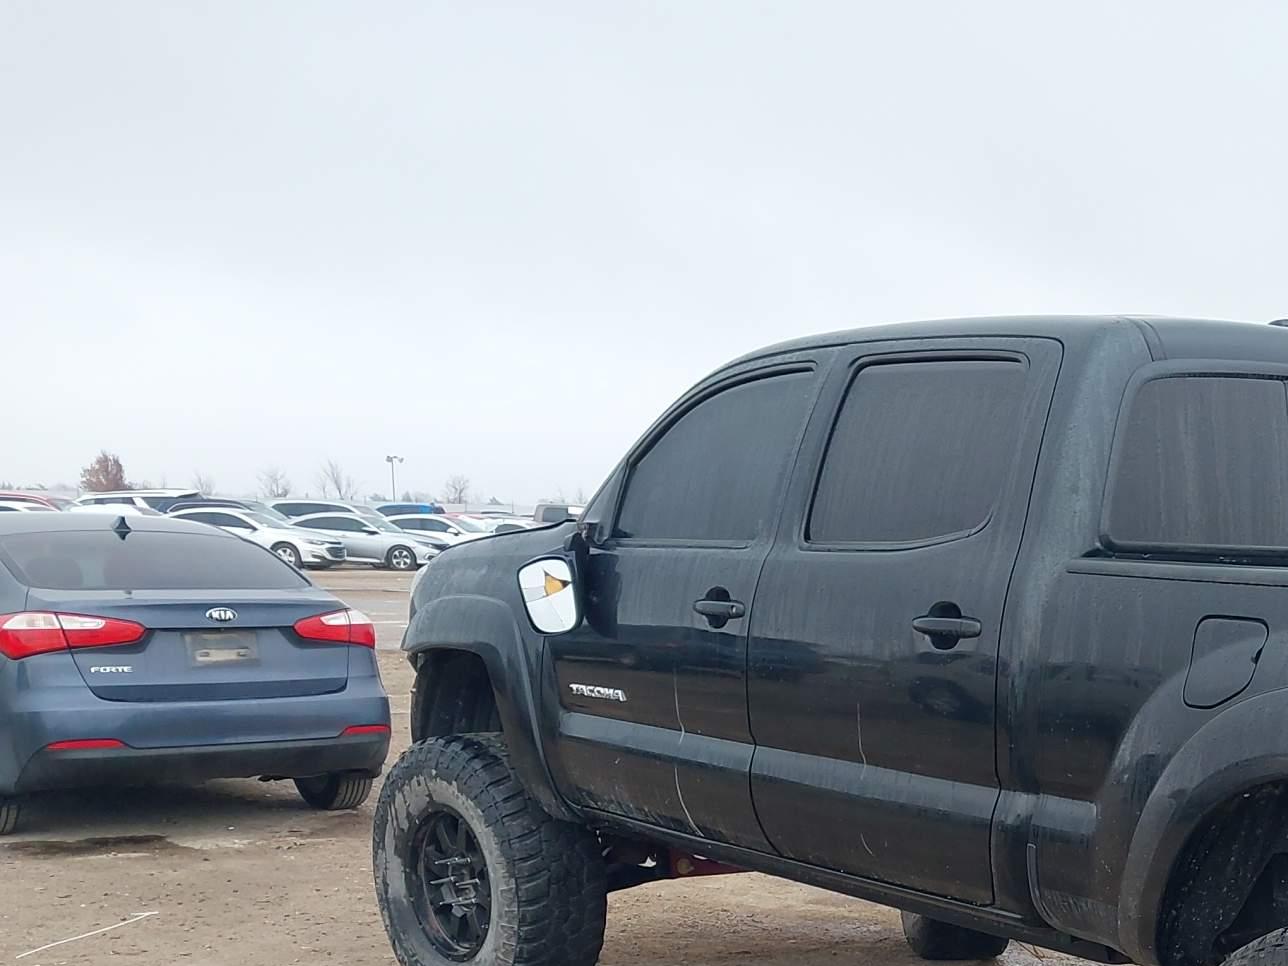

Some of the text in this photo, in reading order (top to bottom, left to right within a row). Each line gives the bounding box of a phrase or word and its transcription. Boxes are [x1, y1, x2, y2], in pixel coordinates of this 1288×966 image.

[210, 610, 234, 621] KIA
[90, 665, 133, 673] FORTE
[569, 683, 628, 702] TACOMA
